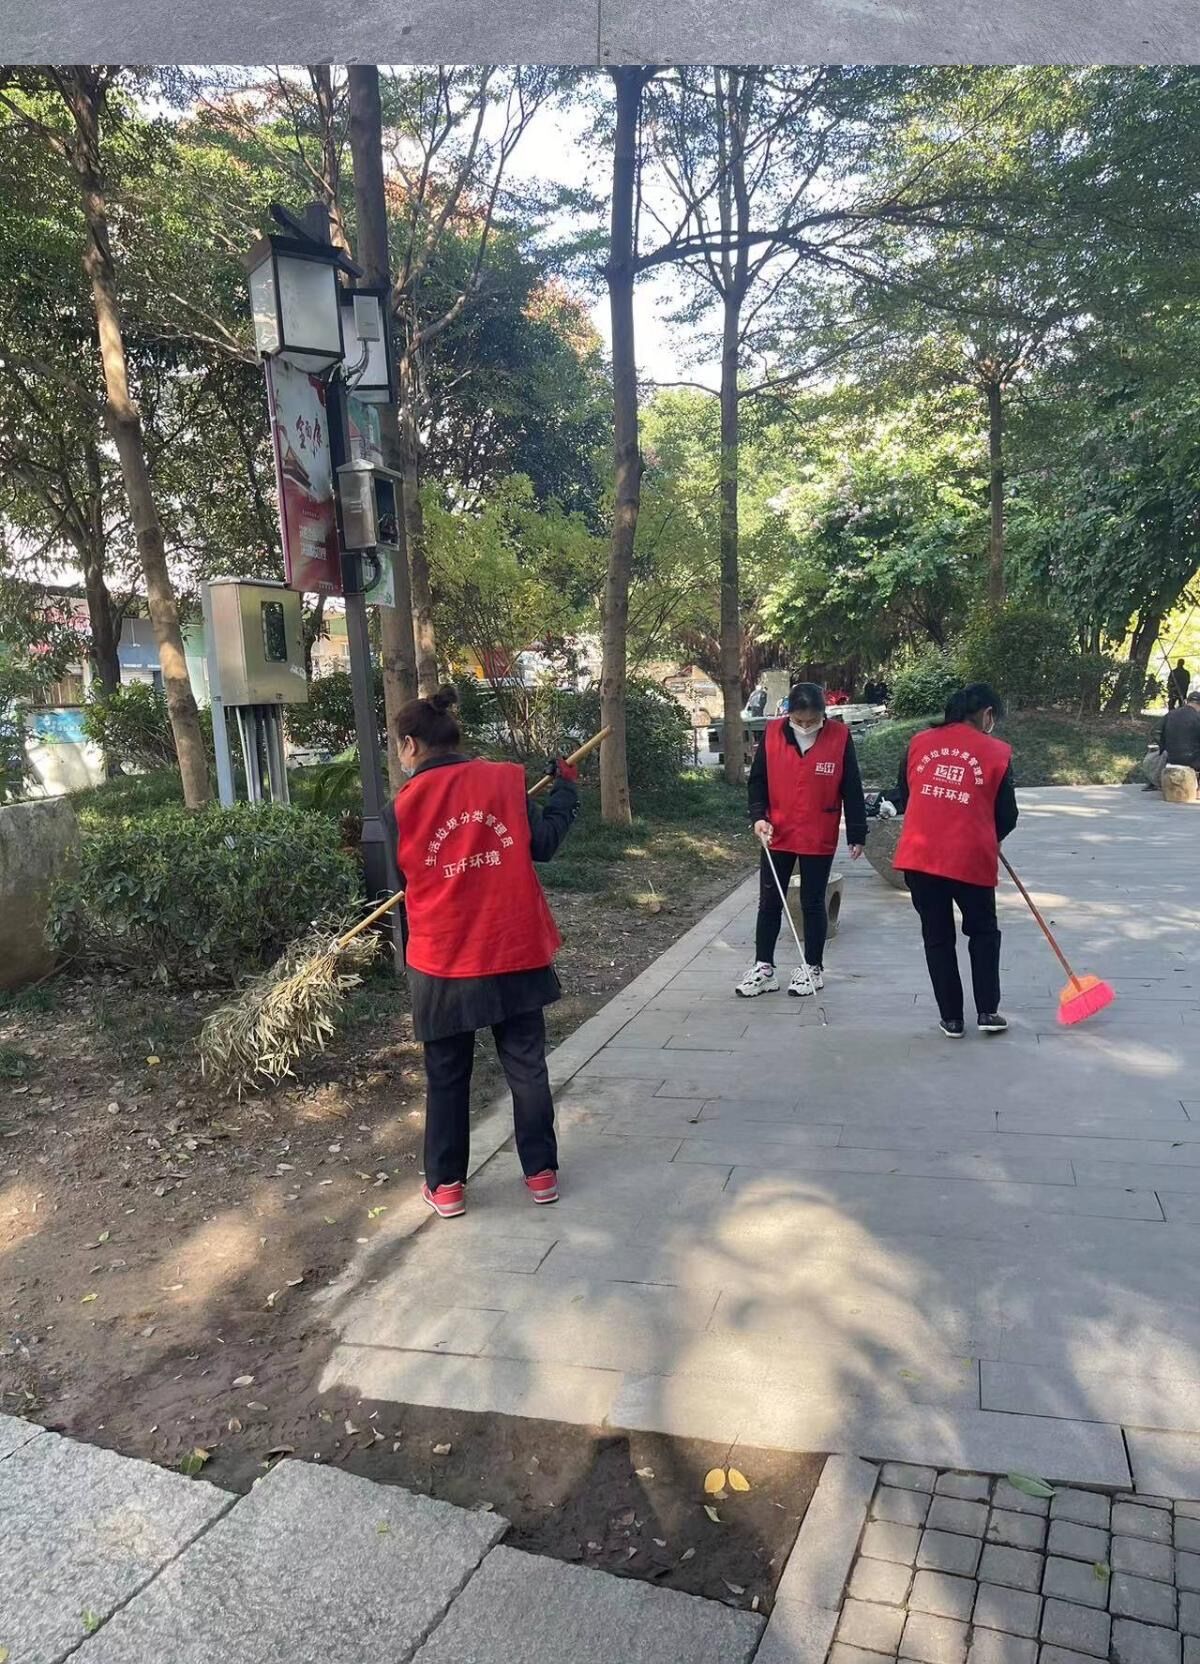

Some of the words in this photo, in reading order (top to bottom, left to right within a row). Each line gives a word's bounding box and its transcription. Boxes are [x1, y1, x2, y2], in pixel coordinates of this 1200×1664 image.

[921, 784, 970, 804] 正轩环境
[425, 810, 514, 867] 生活垃圾分类管理员
